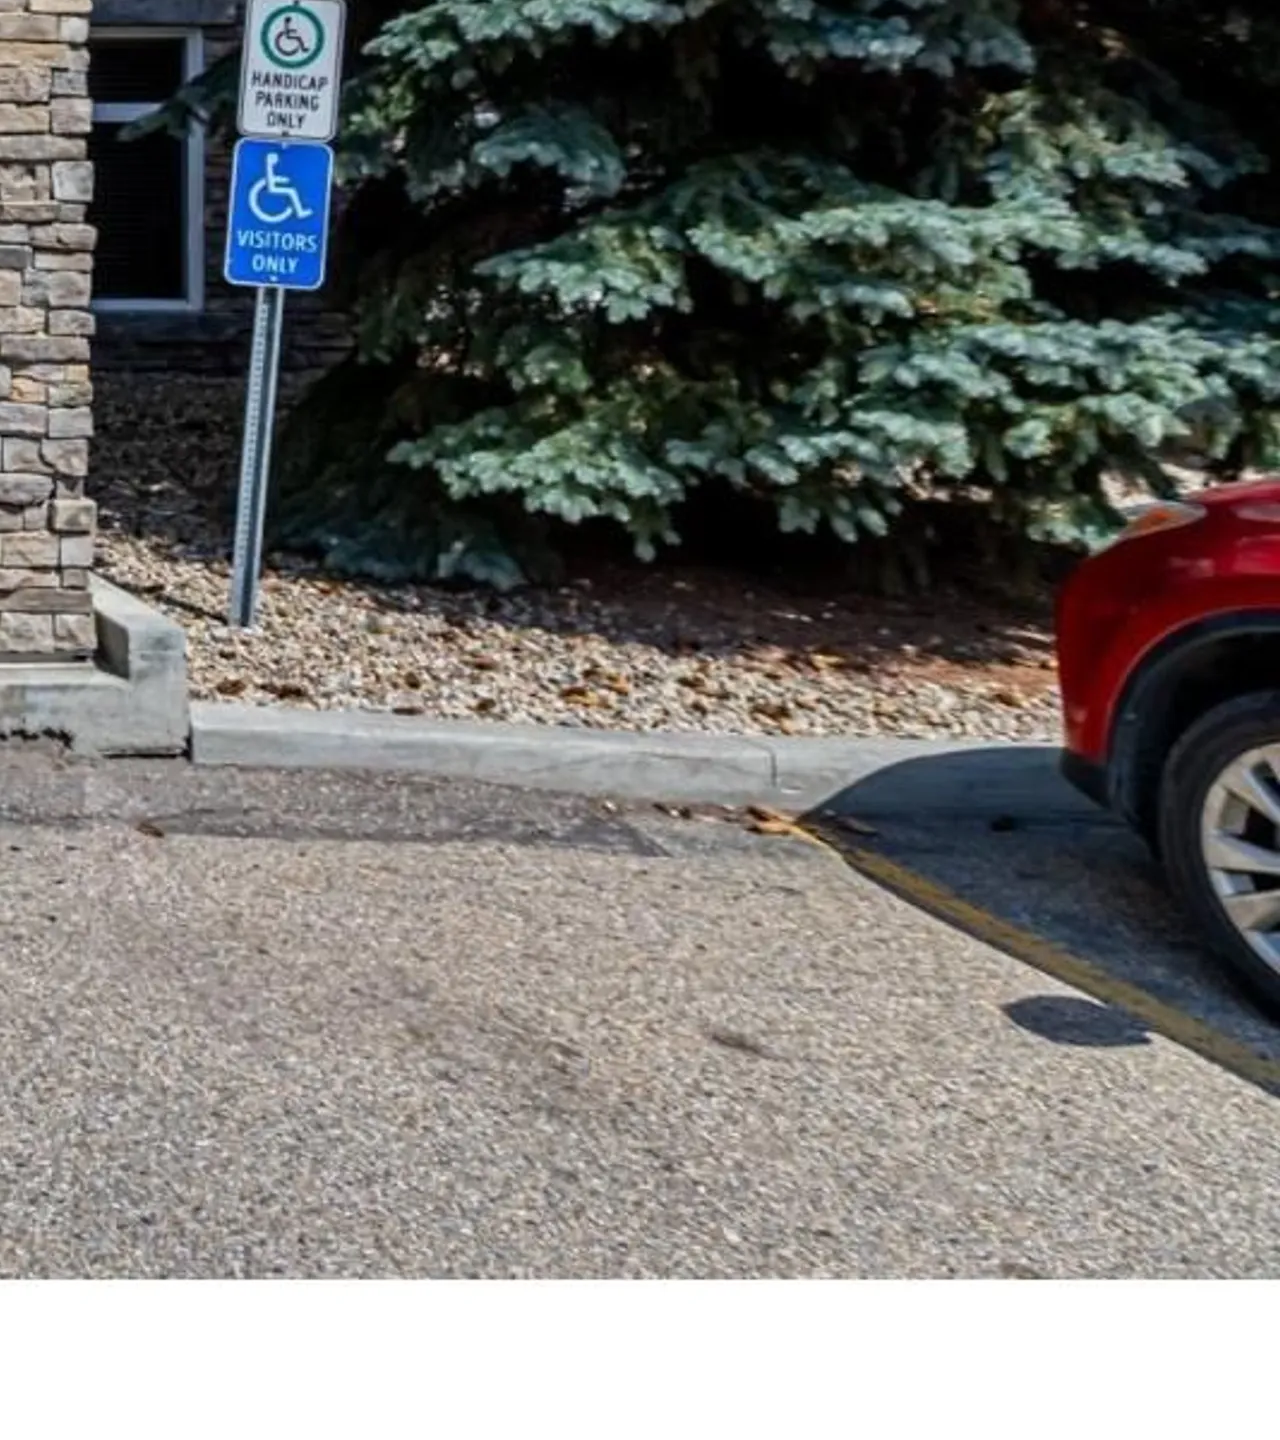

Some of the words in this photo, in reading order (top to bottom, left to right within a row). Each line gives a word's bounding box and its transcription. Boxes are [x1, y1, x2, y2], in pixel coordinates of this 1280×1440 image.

[251, 70, 328, 92] HANDICAP
[255, 91, 320, 112] PARKING
[266, 111, 306, 129] ONLY
[236, 228, 317, 253] VISITORS
[252, 253, 299, 274] ONLY
